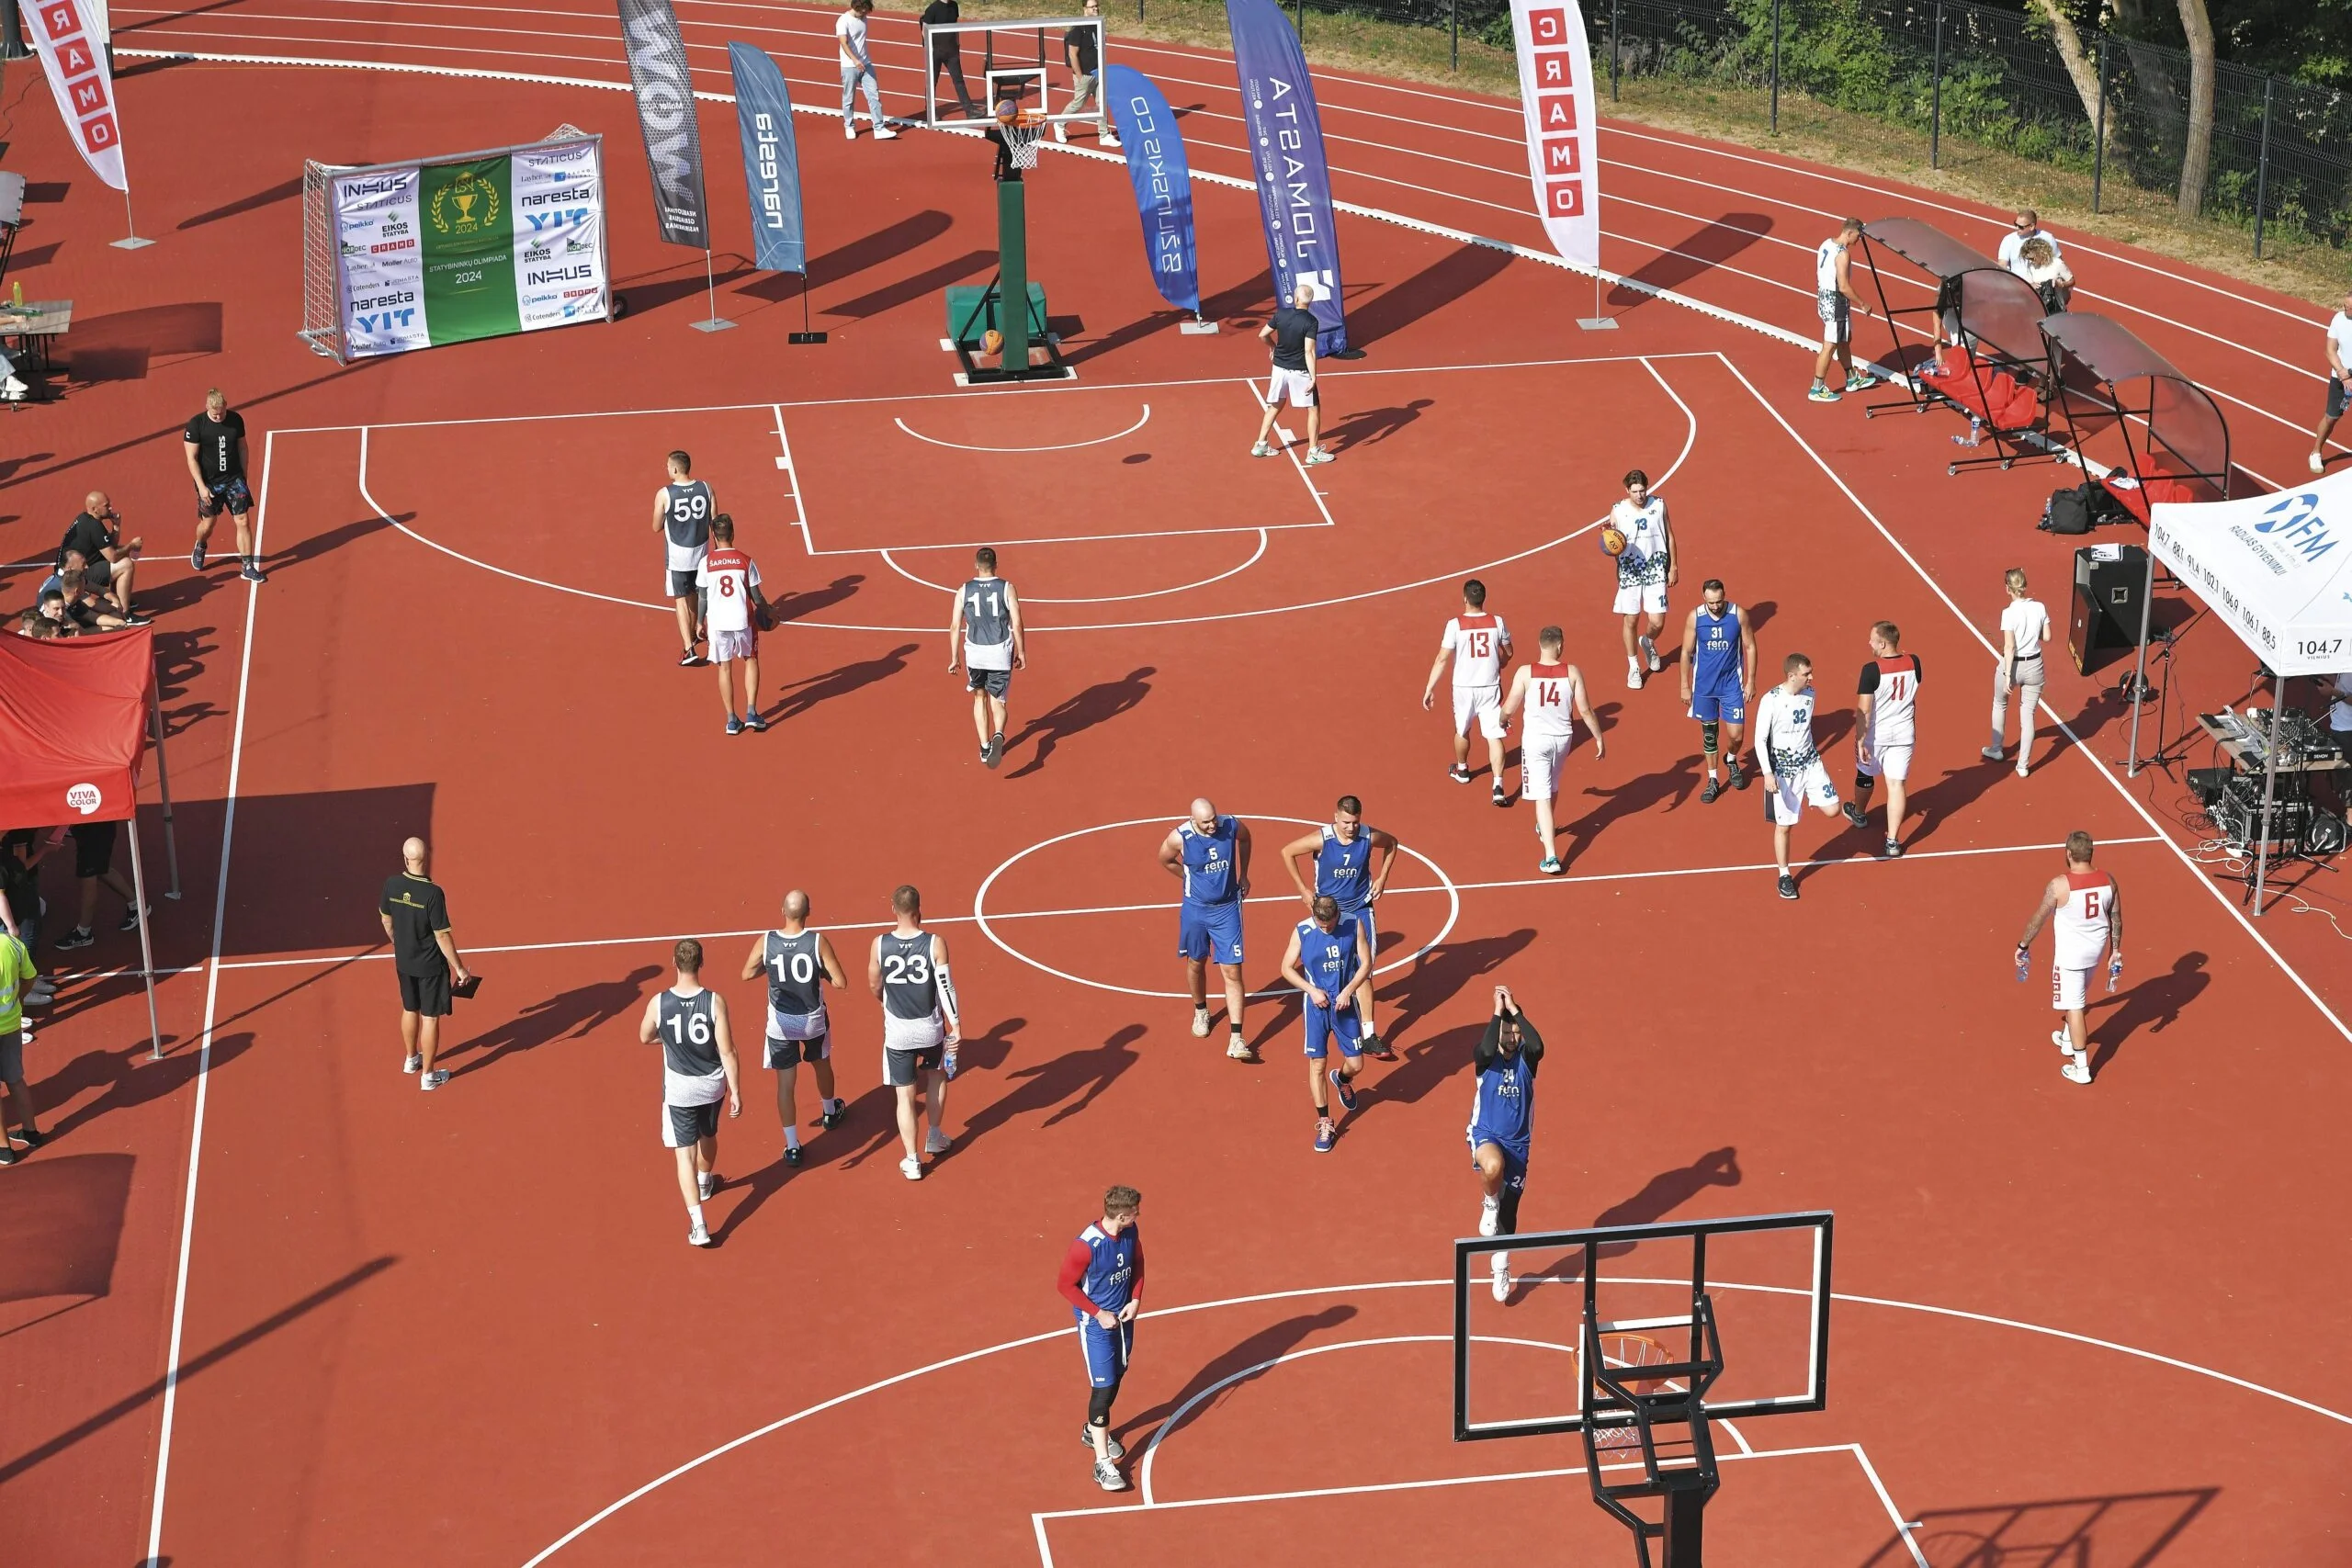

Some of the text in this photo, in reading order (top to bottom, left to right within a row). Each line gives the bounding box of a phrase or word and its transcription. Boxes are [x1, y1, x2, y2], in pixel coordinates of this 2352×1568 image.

[529, 152, 582, 167] STATICUS
[357, 195, 412, 210] STATICUS
[522, 187, 589, 207] naresta
[349, 220, 374, 230] peikko
[382, 222, 408, 231] EIKOS
[525, 208, 588, 231] YIT
[382, 230, 409, 238] STATYBA
[456, 223, 478, 234] 2024
[372, 240, 413, 253] CRAMO
[524, 248, 551, 258] EIKOS
[473, 254, 507, 265] OLIMPIADA
[1820, 248, 1828, 268] 7
[455, 270, 482, 284] 2024
[351, 291, 413, 311] naresta
[532, 294, 558, 303] peikko
[356, 308, 414, 333] YIT
[219, 435, 227, 471] conres
[673, 495, 707, 522] 59
[1635, 518, 1647, 530] 13
[709, 558, 741, 567] ŠARŪNAS
[720, 575, 734, 597] 8
[967, 592, 999, 616] 11
[1711, 626, 1723, 638] 31
[1470, 632, 1489, 658] 13
[1706, 640, 1729, 650] fern
[2298, 639, 2342, 655] 104.7
[1539, 682, 1560, 706] 14
[1892, 676, 1905, 701] 11
[1733, 708, 1744, 719] 31
[1793, 709, 1807, 724] 32
[70, 790, 96, 799] VIVA
[1209, 848, 1217, 860] 5
[1343, 853, 1350, 866] 7
[1204, 859, 1228, 874] fern
[1333, 867, 1357, 877] fern
[2086, 892, 2098, 919] 6
[1234, 945, 1241, 957] 5
[1326, 945, 1340, 959] 18
[771, 953, 814, 984] 10
[884, 954, 929, 984] 23
[1323, 959, 1344, 972] fern
[666, 1012, 710, 1044] 16
[1352, 1037, 1362, 1050] 18
[1503, 1068, 1514, 1083] 24
[1511, 1176, 1525, 1190] 24
[1117, 1253, 1124, 1267] 3
[1110, 1267, 1131, 1286] fern
